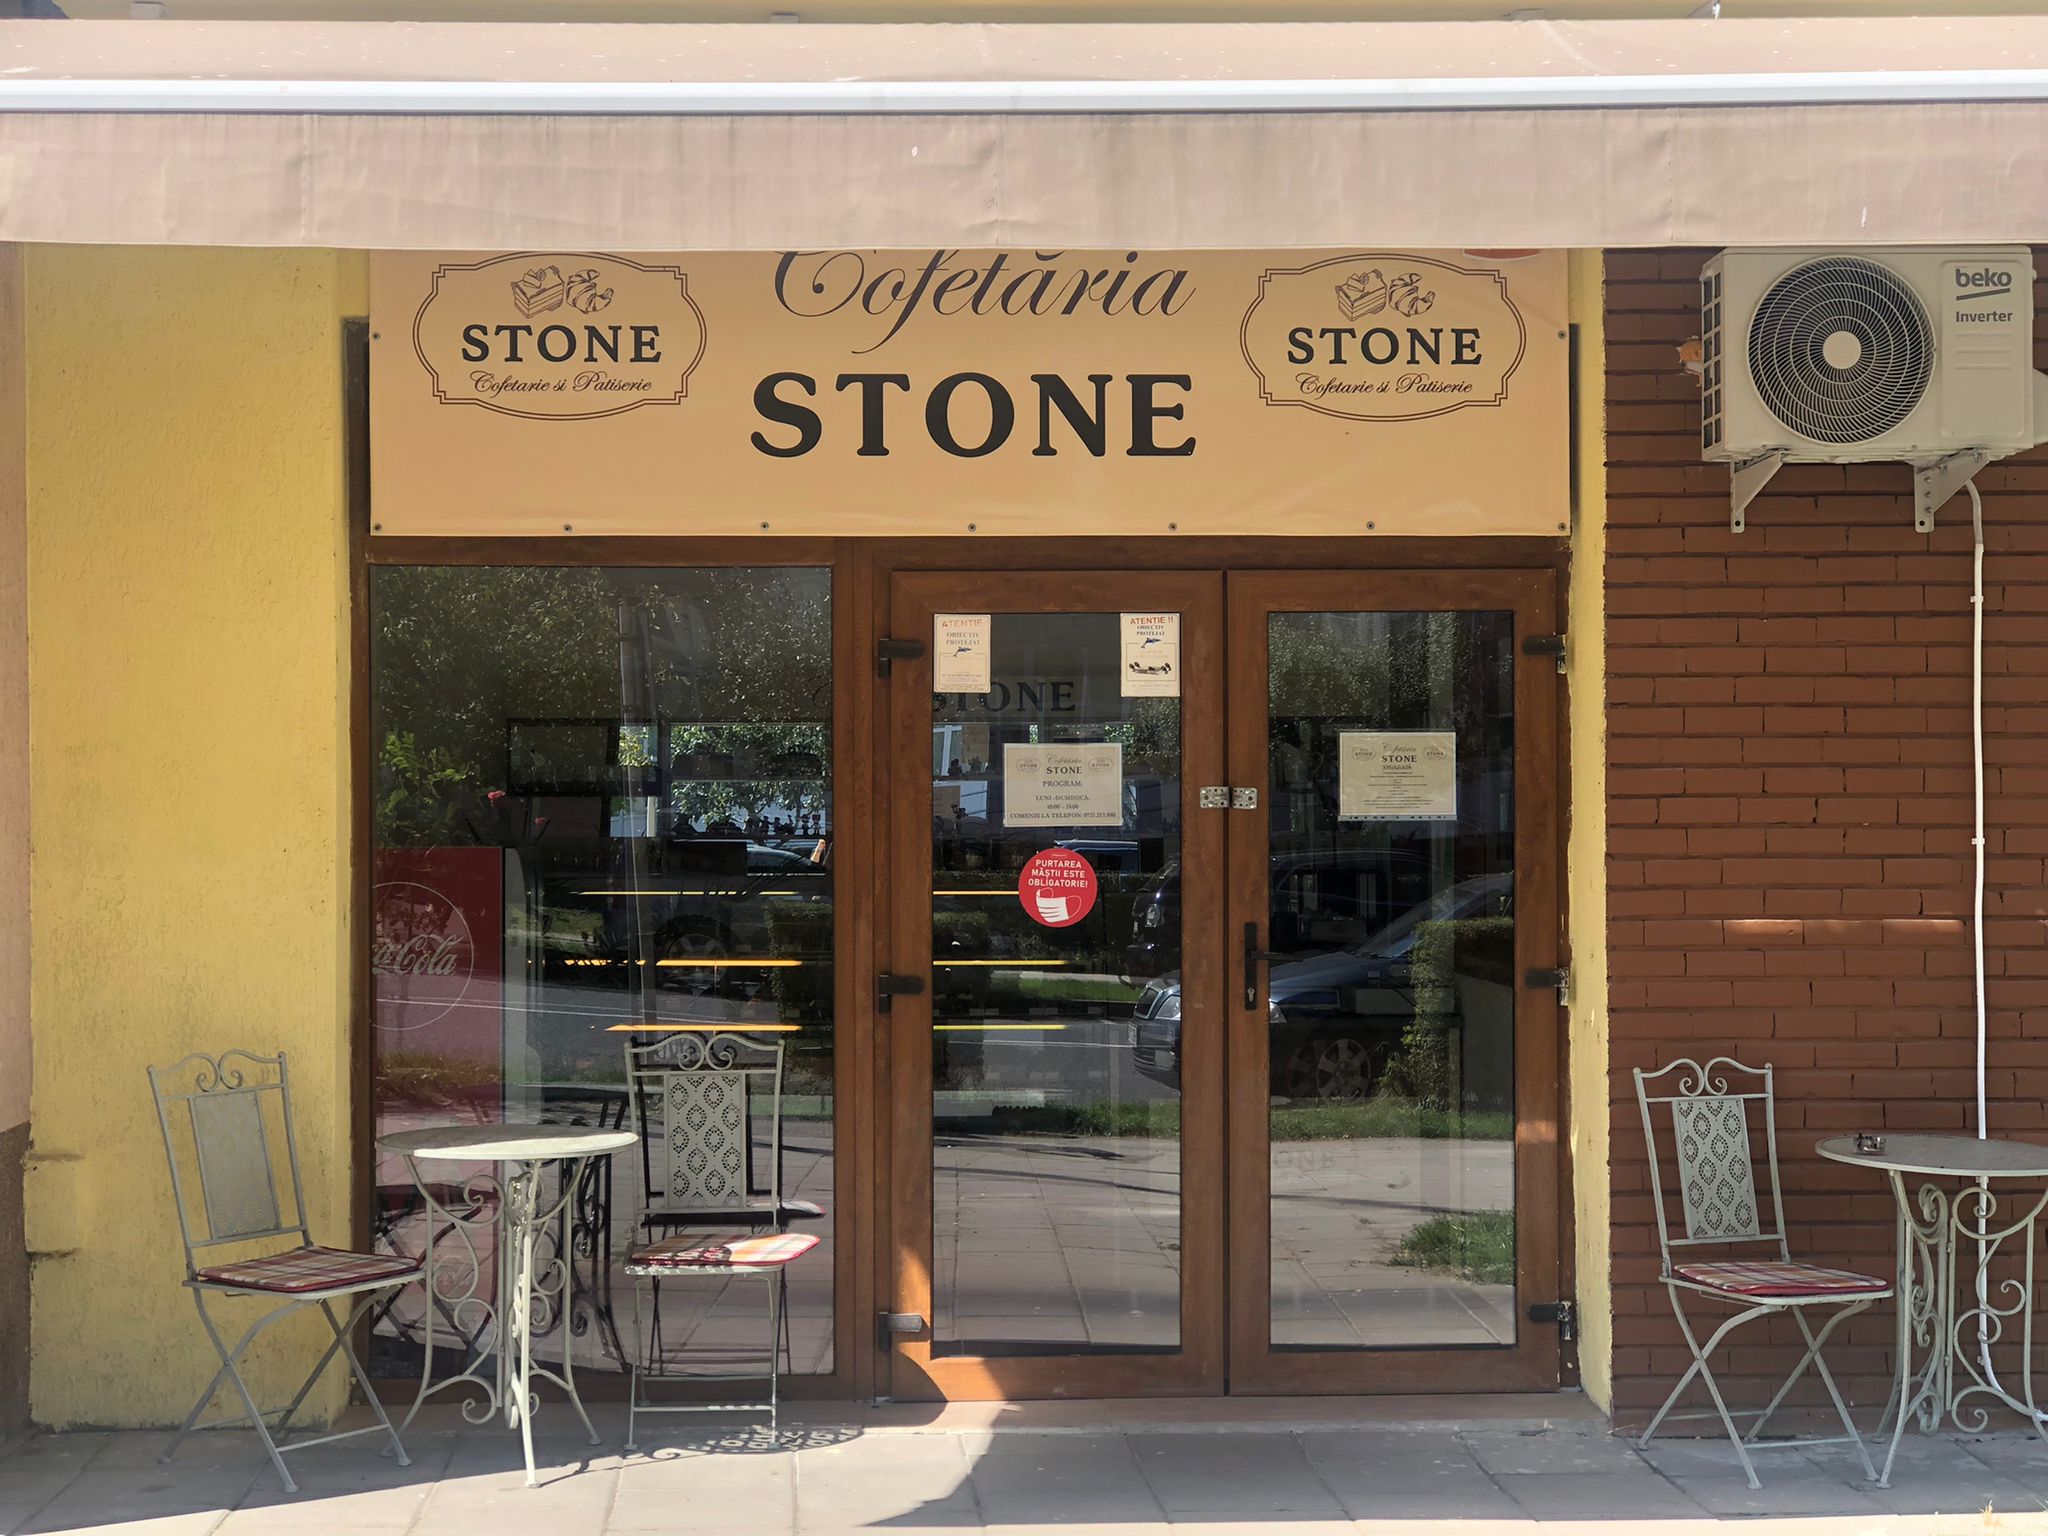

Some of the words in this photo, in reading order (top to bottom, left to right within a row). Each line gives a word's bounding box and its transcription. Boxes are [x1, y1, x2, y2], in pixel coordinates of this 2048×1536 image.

[1955, 268, 2012, 287] beko
[775, 250, 1197, 354] Cofetăria
[1956, 311, 2013, 322] Inverter
[462, 324, 662, 363] STONE
[1287, 327, 1483, 366] STONE
[470, 370, 550, 398] Cofetarie
[552, 376, 567, 392] si
[573, 370, 652, 392] Patiserie
[1295, 372, 1373, 400] Cofetarie
[1376, 379, 1390, 394] si
[1395, 372, 1473, 394] Patiserie
[750, 371, 1197, 458] STONE
[942, 619, 983, 628] ATENTIE
[1130, 617, 1166, 625] ATENTIE
[1382, 755, 1417, 763] STONE
[1046, 767, 1083, 775] STONE
[1036, 859, 1082, 868] PURTAREA
[1063, 870, 1086, 878] ESTE
[1028, 878, 1088, 888] OBLIGATORIE!
